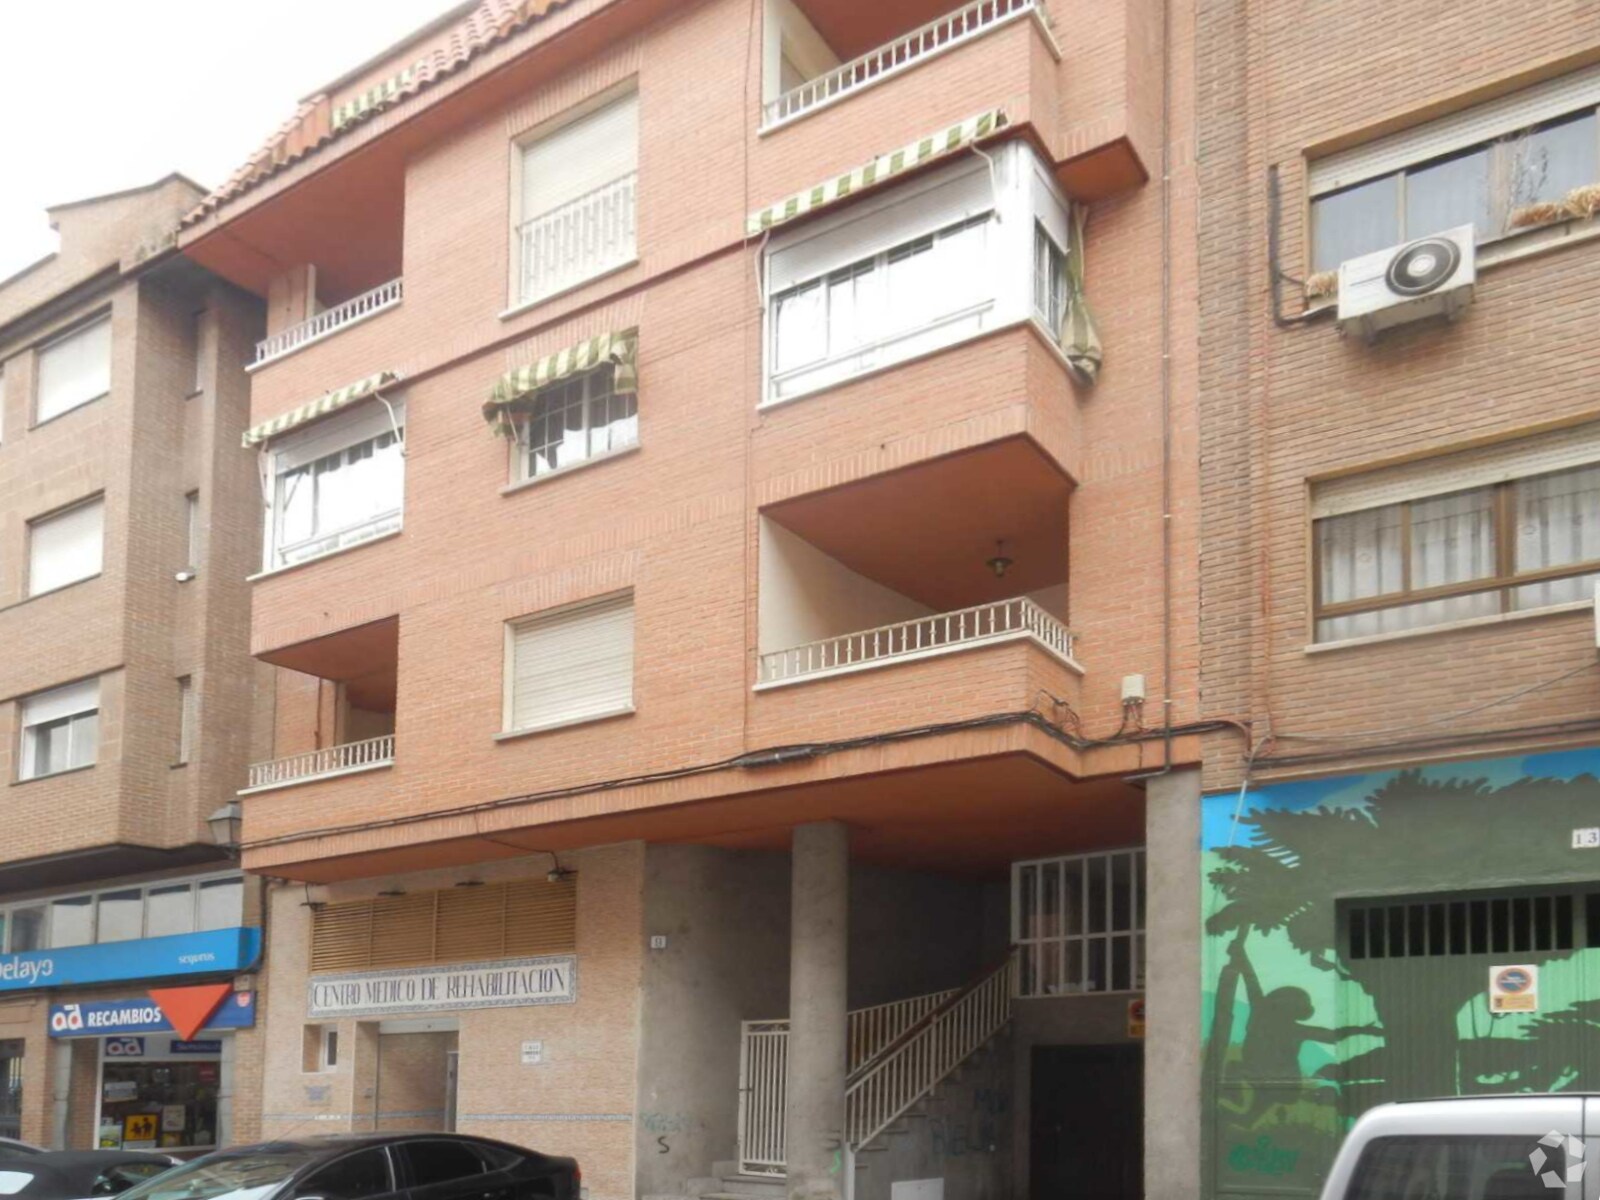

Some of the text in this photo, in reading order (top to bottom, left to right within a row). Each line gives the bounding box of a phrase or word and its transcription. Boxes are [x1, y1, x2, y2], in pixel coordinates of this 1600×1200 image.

[1576, 831, 1597, 845] 13
[178, 951, 216, 965] seguros
[0, 956, 54, 984] elayo
[314, 967, 566, 1007] CENTRO MEDICO DE REHABILITACION
[87, 1007, 162, 1028] RECAMBIOS
